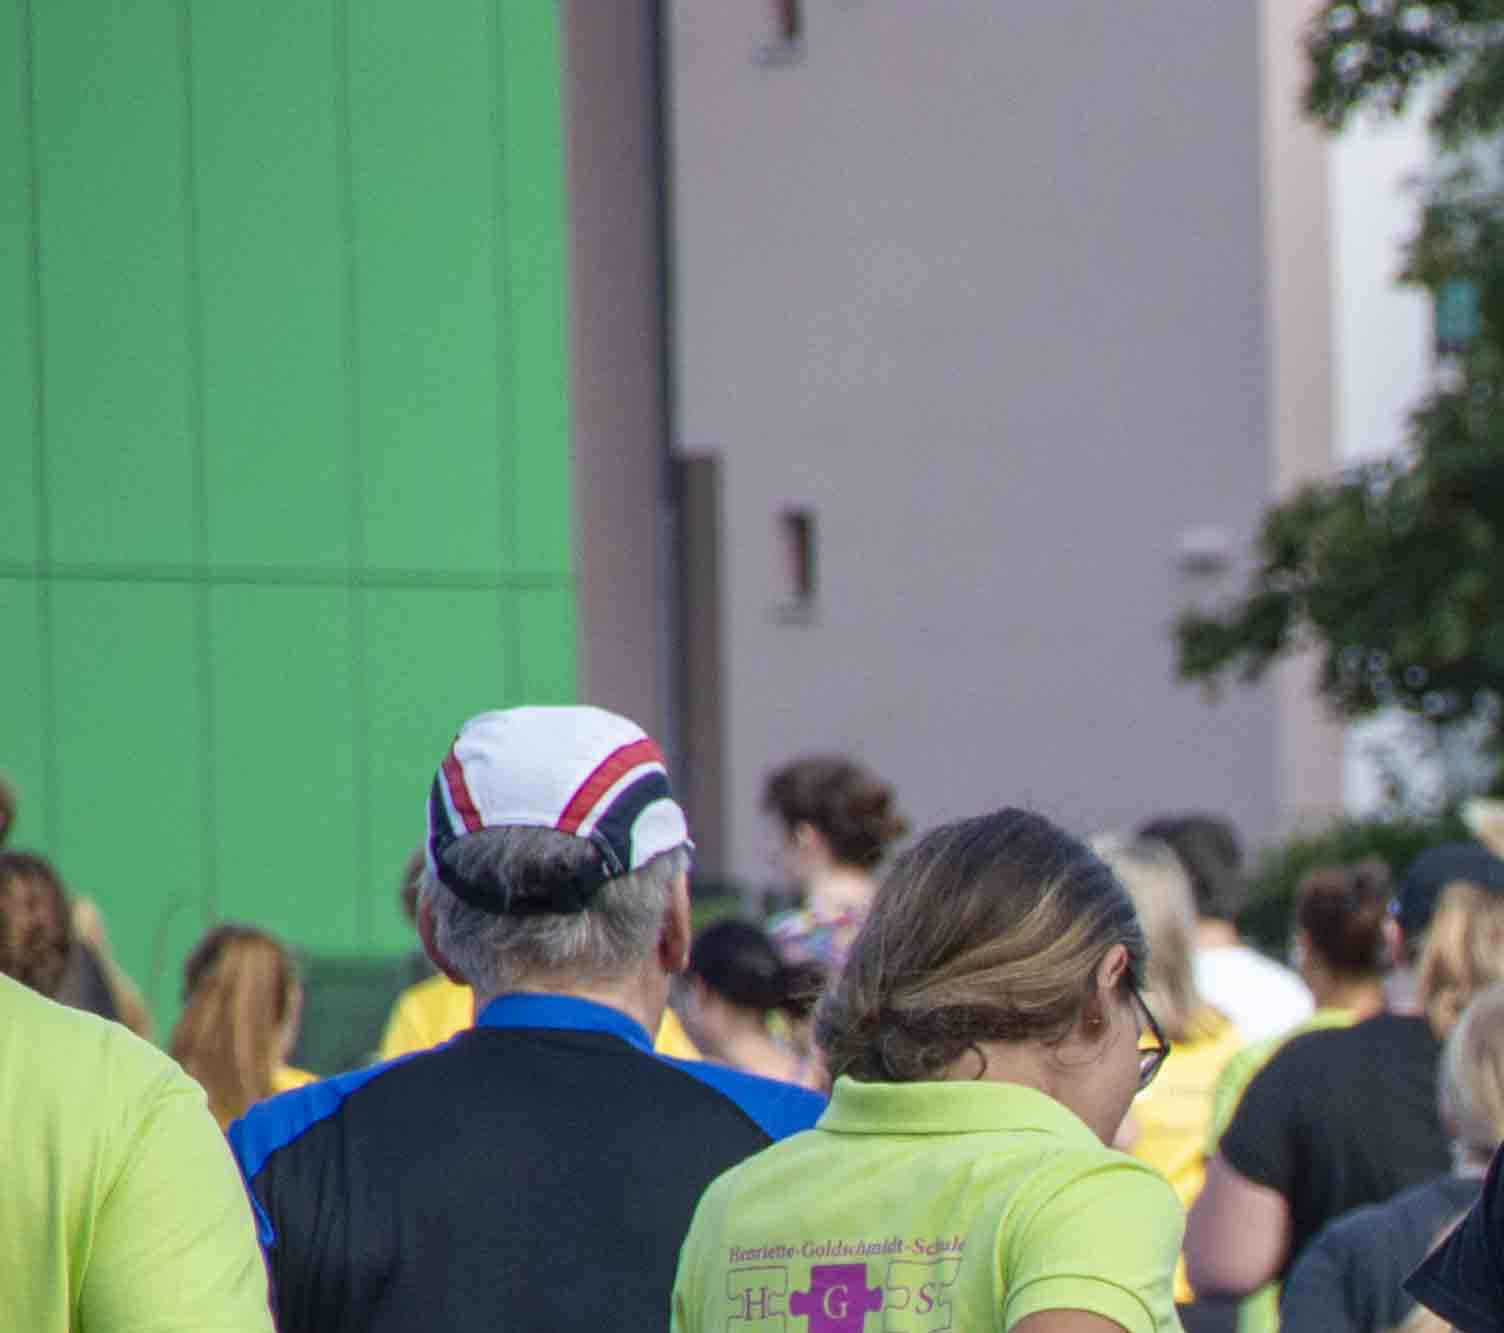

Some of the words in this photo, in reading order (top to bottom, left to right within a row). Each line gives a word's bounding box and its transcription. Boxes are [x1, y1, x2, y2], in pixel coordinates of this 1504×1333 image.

[742, 1286, 769, 1321] H
[822, 1284, 849, 1320] G
[914, 1281, 936, 1314] S
